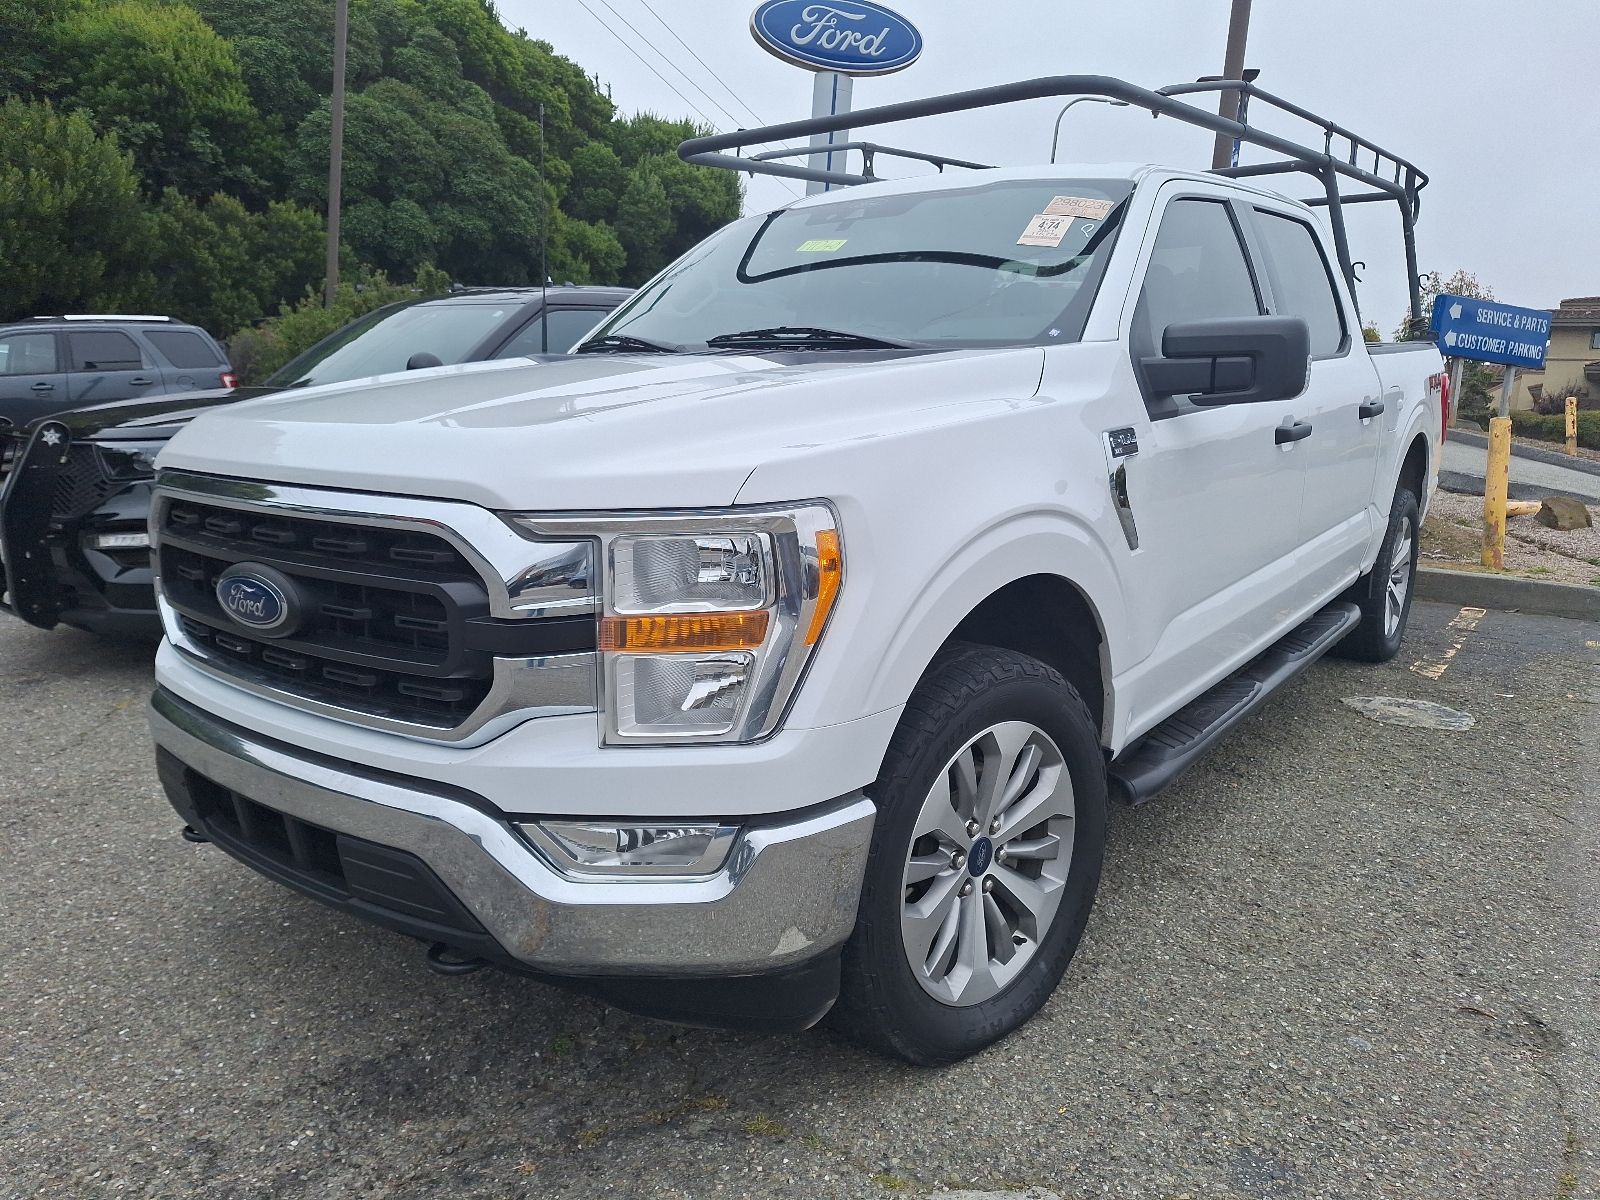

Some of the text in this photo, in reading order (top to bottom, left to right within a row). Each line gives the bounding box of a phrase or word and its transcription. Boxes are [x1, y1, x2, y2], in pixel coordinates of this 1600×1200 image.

[790, 5, 891, 56] Ford
[1476, 308, 1548, 333] SERVICE & PARTS
[1457, 333, 1543, 360] CUSTOMER PARKING
[228, 583, 266, 617] Ford
